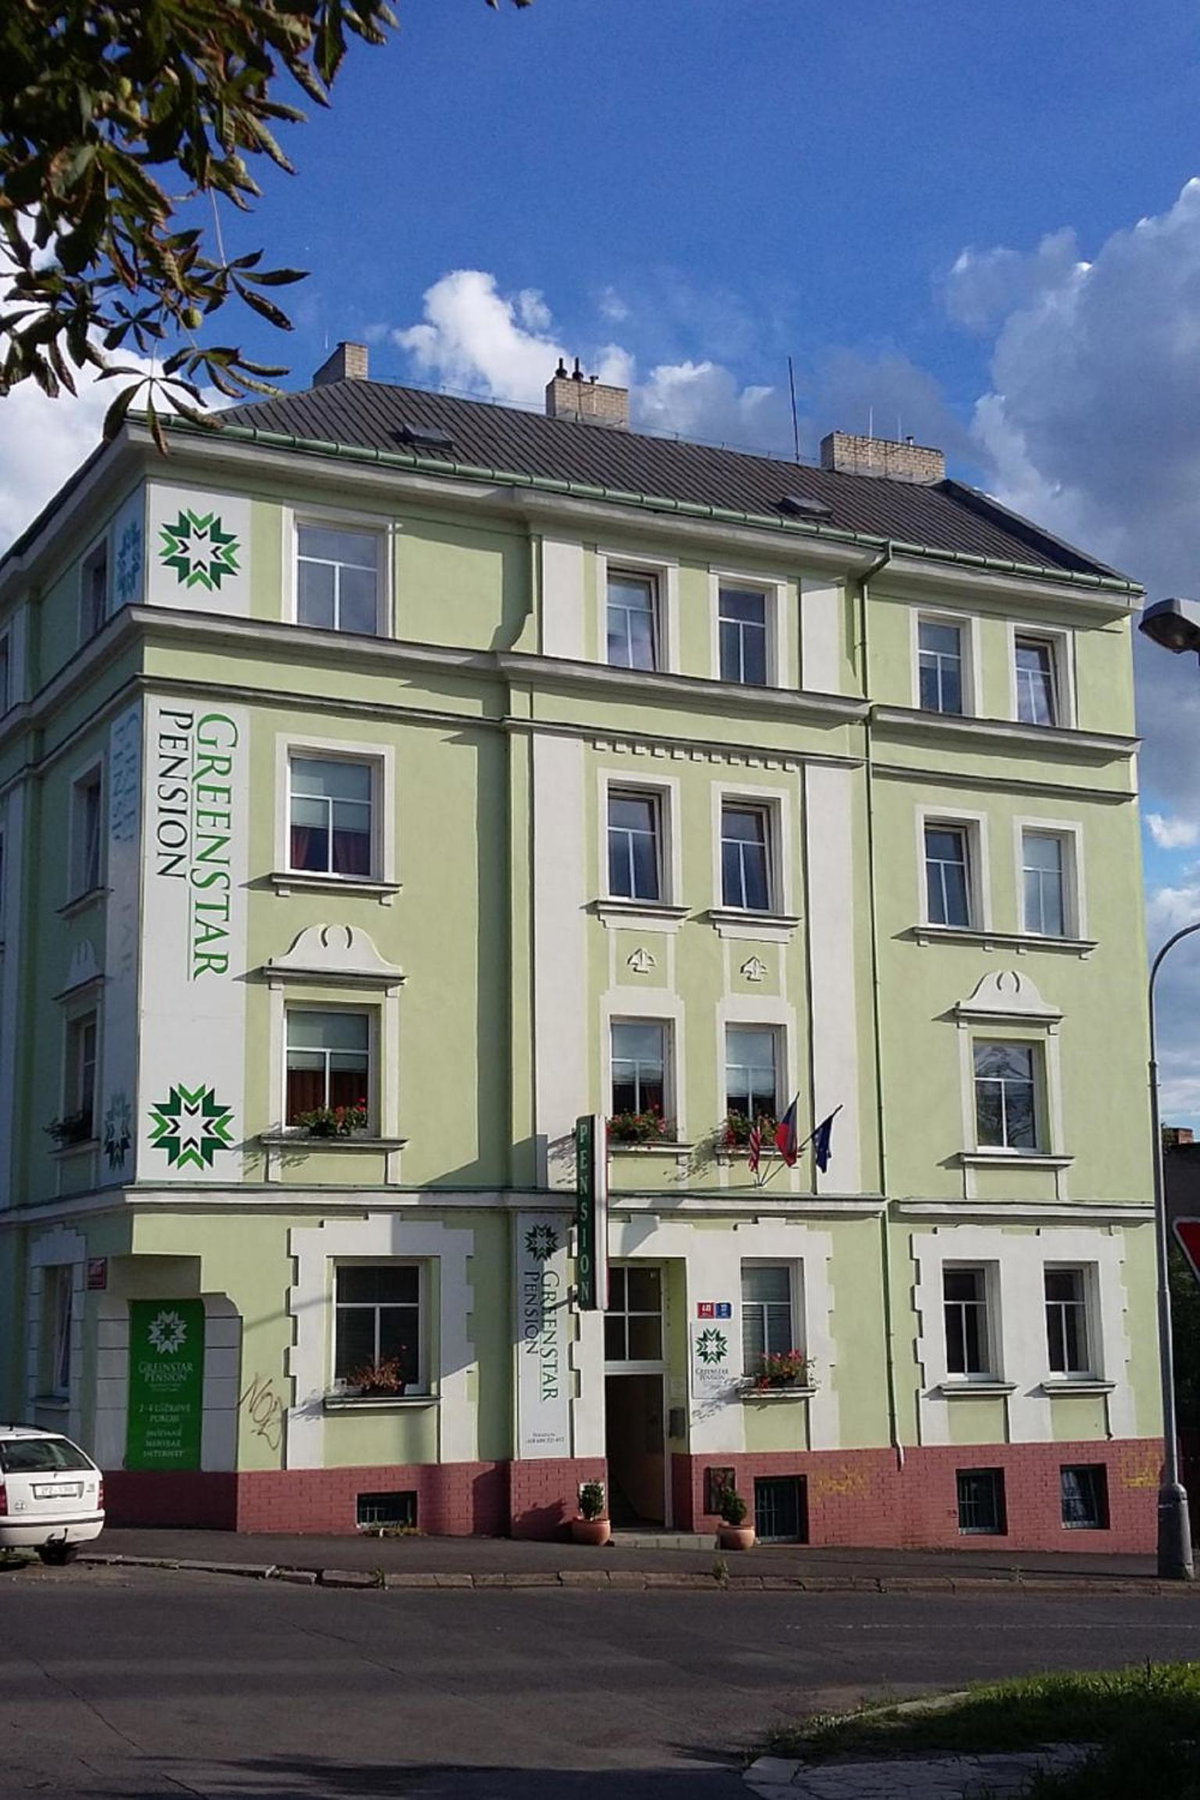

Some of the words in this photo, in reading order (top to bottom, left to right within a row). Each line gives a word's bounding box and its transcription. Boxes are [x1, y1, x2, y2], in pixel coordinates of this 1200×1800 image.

[156, 708, 194, 880] PENSION
[190, 712, 240, 981] GREENSTAR
[578, 1124, 591, 1302] PENSION
[144, 1372, 188, 1382] PENSION
[523, 1271, 541, 1354] PENSION
[540, 1270, 560, 1402] GREENSTAR
